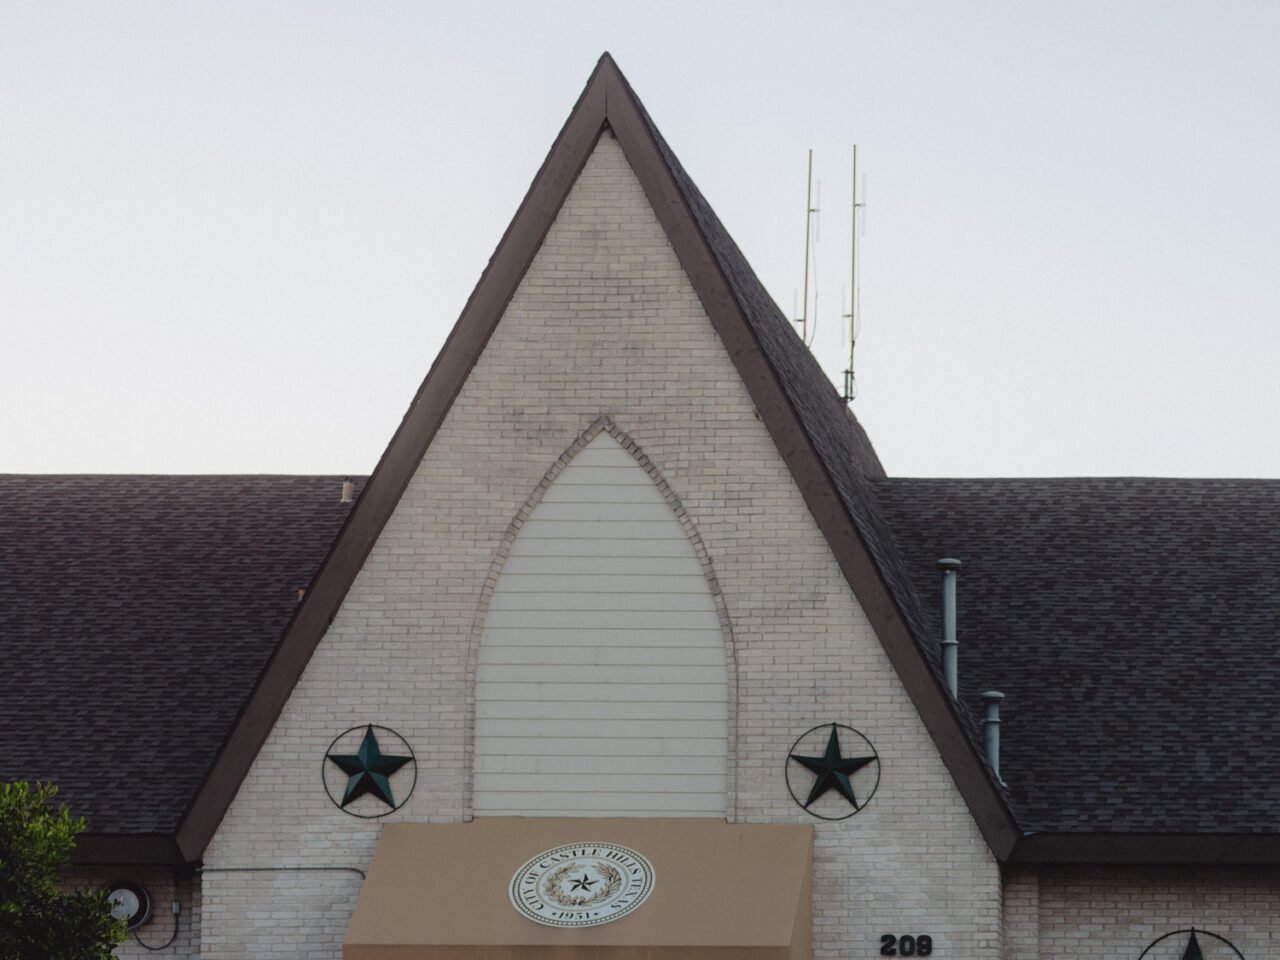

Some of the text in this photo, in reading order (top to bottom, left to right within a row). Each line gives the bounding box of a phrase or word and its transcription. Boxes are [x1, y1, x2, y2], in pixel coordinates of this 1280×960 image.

[522, 848, 643, 912] CITY OF CASTLE HILLS TEXAS
[558, 911, 590, 920] 1951
[880, 934, 932, 956] 209
